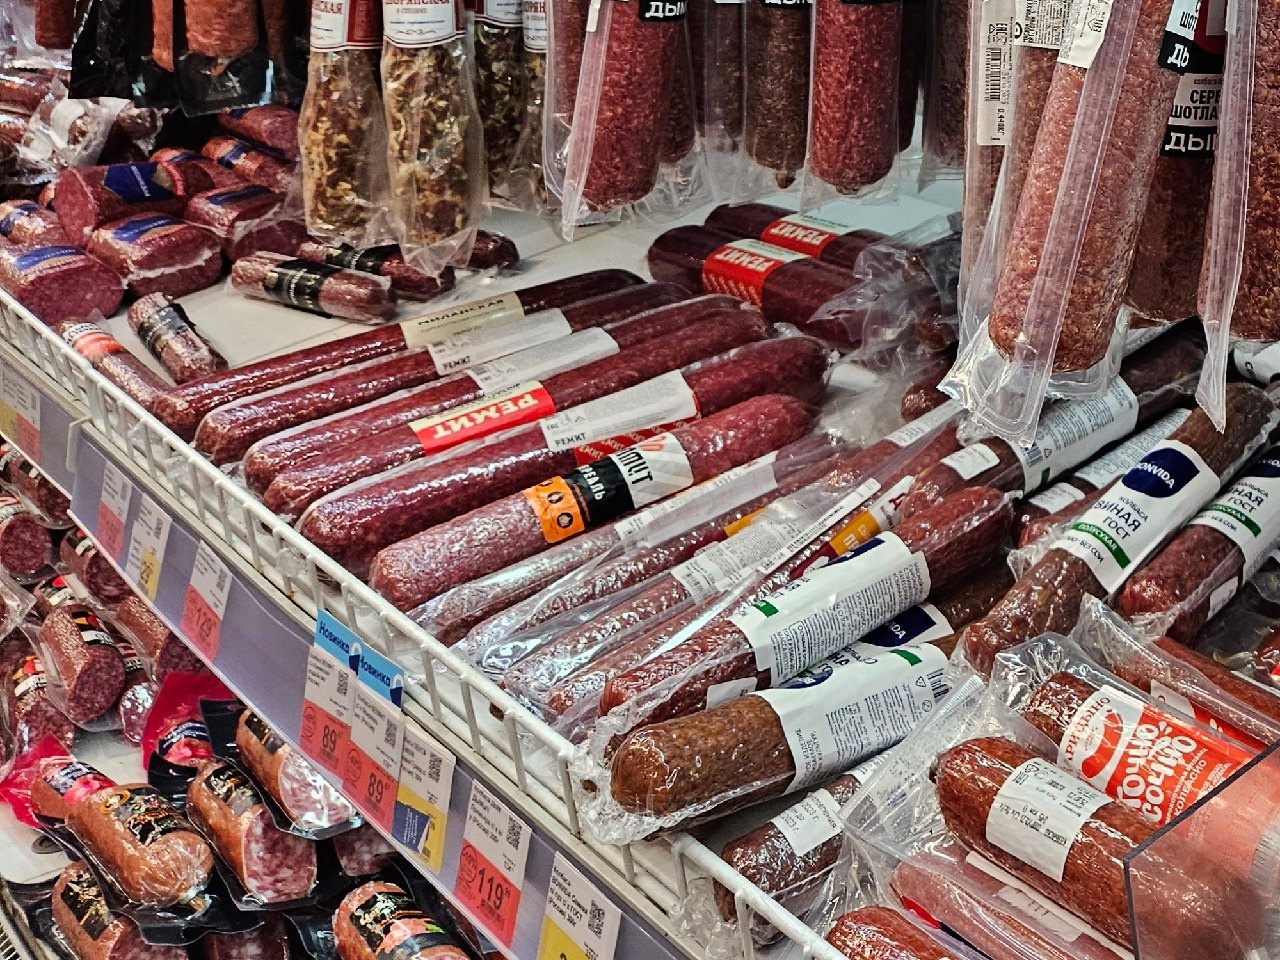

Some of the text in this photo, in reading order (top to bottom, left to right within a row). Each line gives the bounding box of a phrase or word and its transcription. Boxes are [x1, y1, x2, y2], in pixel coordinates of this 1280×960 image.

[769, 223, 829, 245] РЕМИТ
[714, 249, 777, 271] РЕМИТ
[432, 391, 539, 439] РЕМИТ
[1228, 495, 1257, 513] ГОСТ
[1103, 516, 1131, 539] ГОСТ
[319, 620, 350, 653] Новинка
[322, 724, 337, 753] 89
[368, 772, 384, 803] 89
[478, 868, 503, 908] 119
